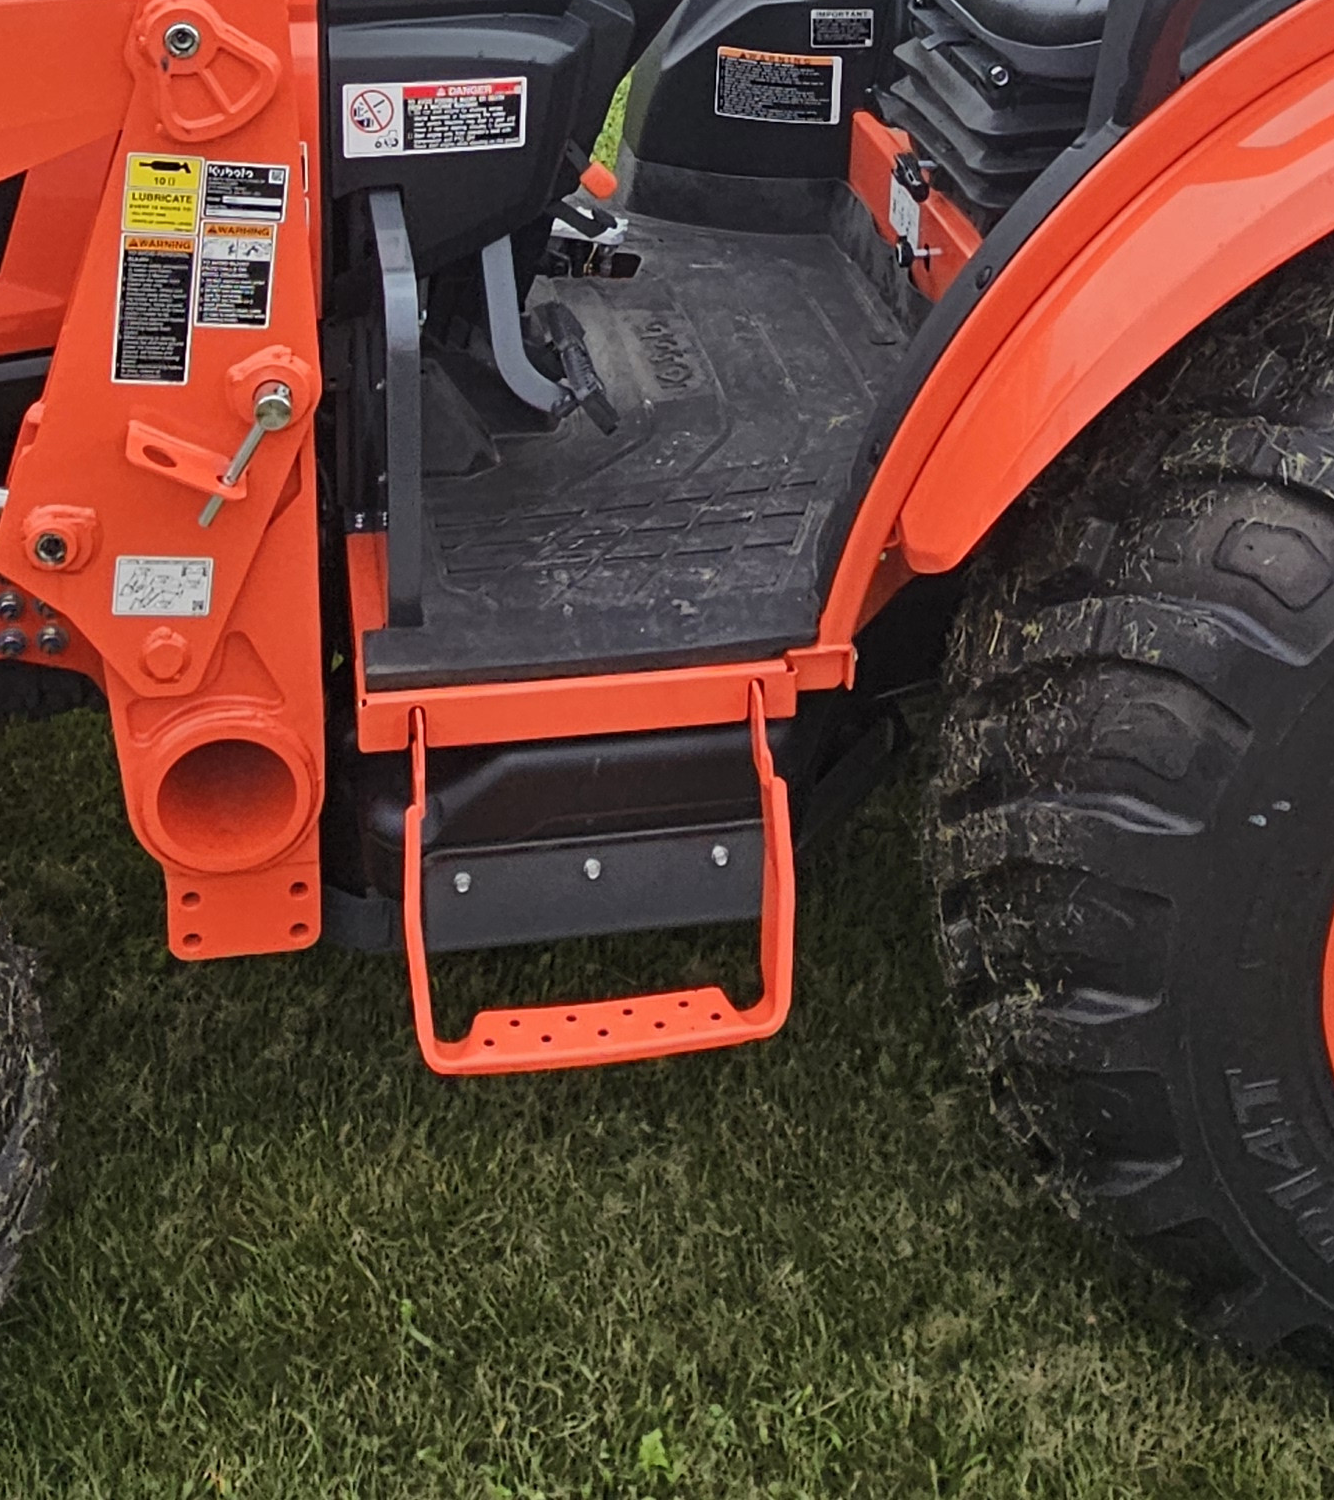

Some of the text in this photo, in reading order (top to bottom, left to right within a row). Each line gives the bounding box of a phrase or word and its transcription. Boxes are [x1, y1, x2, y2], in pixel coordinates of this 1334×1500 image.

[816, 10, 868, 18] IMPORTANT
[448, 85, 493, 96] DANGER
[208, 166, 254, 178] Kubota
[131, 192, 193, 204] LUBRICATE
[217, 226, 270, 237] WARNING
[140, 239, 191, 250] WARNING
